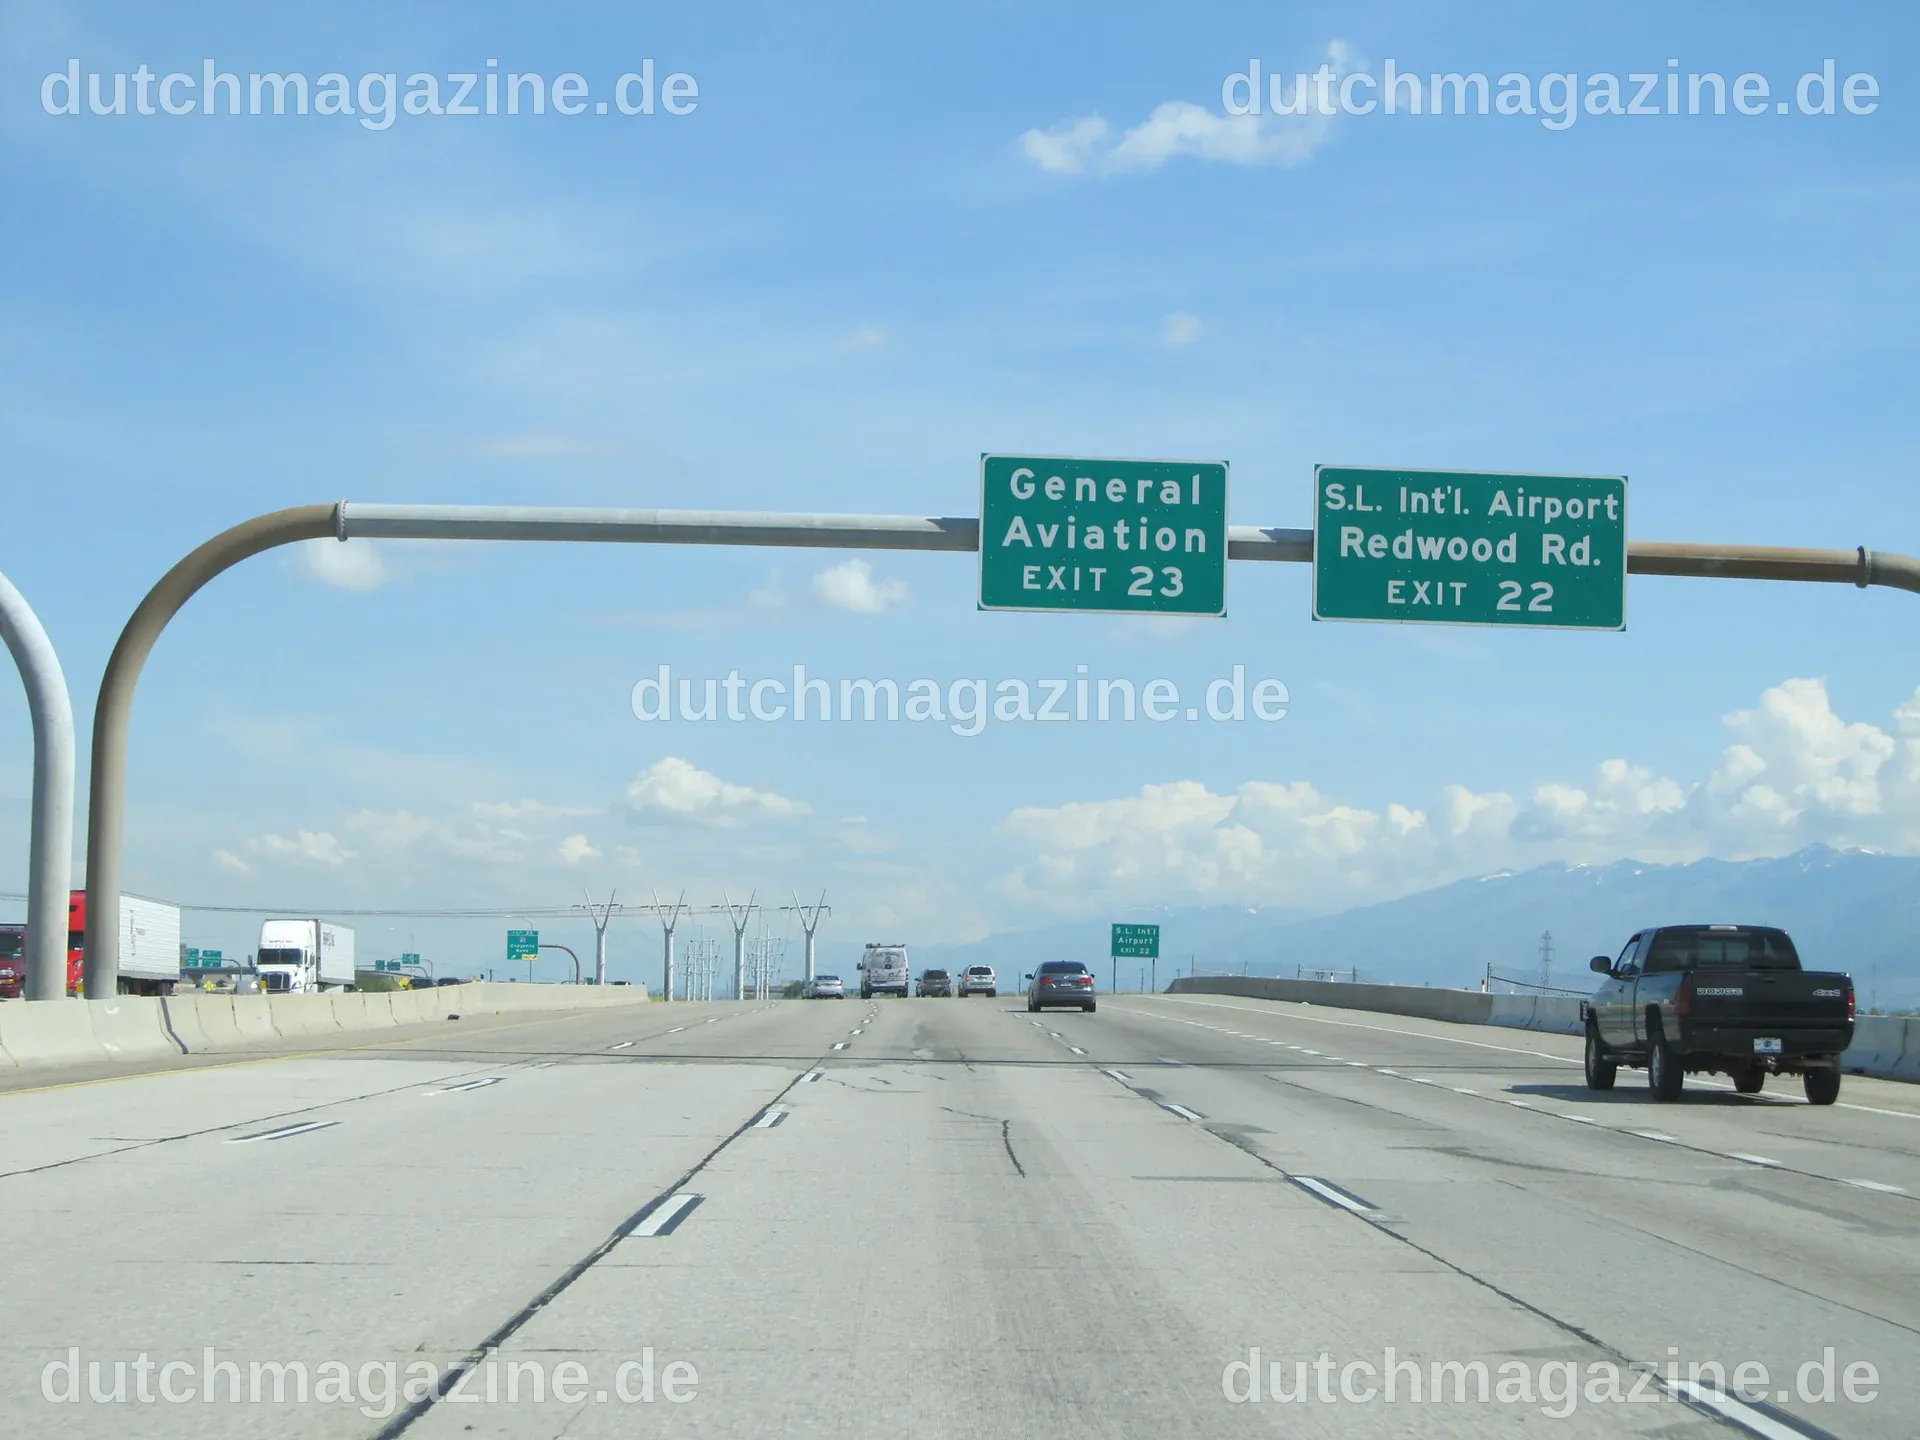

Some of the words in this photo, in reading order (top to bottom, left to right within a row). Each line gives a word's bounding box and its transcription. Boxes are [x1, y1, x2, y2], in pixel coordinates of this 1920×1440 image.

[1010, 468, 1200, 505] General
[1325, 483, 1382, 512] S.L.
[1488, 488, 1618, 524] Airport
[1001, 515, 1206, 552] Aviation
[1340, 526, 1517, 563] Redwood
[1542, 533, 1601, 566] Rd.
[1023, 565, 1107, 591] EXIT
[1127, 565, 1184, 597] 23
[1387, 580, 1467, 606] EXIT
[1496, 581, 1554, 612] 22
[1118, 936, 1153, 946] Airport
[1697, 987, 1743, 996] DODGE
